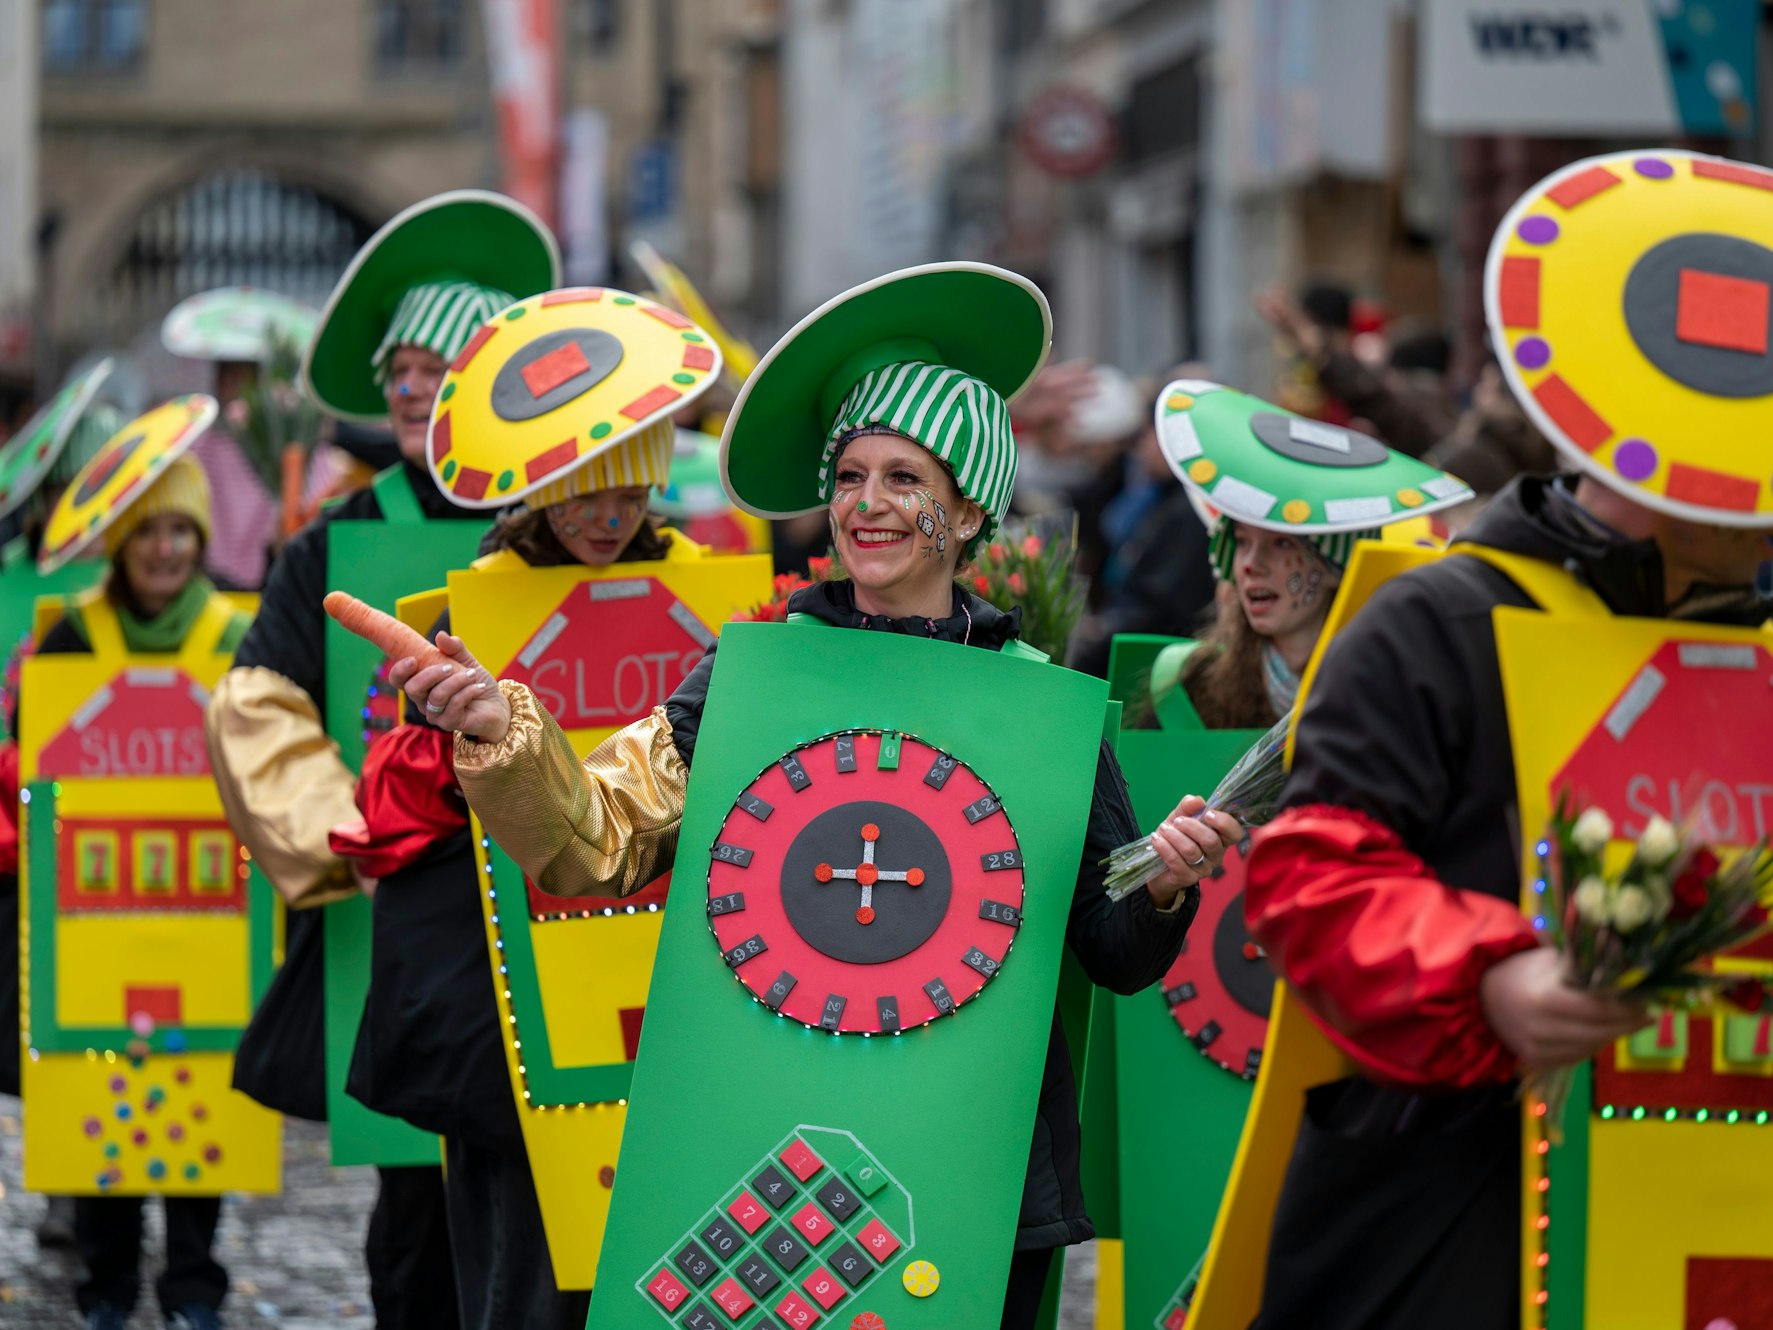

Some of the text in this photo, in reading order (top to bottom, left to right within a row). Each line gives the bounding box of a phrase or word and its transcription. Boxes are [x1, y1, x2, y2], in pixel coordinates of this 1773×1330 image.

[80, 727, 206, 778] SLOTS
[837, 741, 854, 764] 17
[885, 745, 896, 758] 0
[783, 758, 804, 782] 31
[930, 755, 953, 781] 38
[747, 800, 760, 813] 7
[968, 798, 995, 819] 12
[720, 846, 745, 863] 26
[988, 851, 1015, 869] 28
[712, 894, 736, 913] 18
[988, 904, 1014, 921] 16
[733, 940, 759, 962] 36
[970, 951, 997, 975] 32
[931, 984, 952, 1009] 15
[822, 1001, 841, 1025] 21
[882, 1008, 896, 1020] 4
[859, 1167, 873, 1180] 0
[768, 1182, 782, 1195] 4
[830, 1192, 845, 1207] 2
[742, 1206, 756, 1219] 7
[805, 1215, 820, 1230] 5
[709, 1227, 732, 1250] 10
[778, 1240, 793, 1254] 8
[872, 1233, 887, 1248] 3
[683, 1253, 707, 1275] 13
[843, 1257, 857, 1271] 6
[744, 1263, 768, 1286] 11
[655, 1278, 679, 1302] 16
[815, 1281, 830, 1294] 9
[718, 1288, 741, 1313] 14
[783, 1302, 808, 1326] 12
